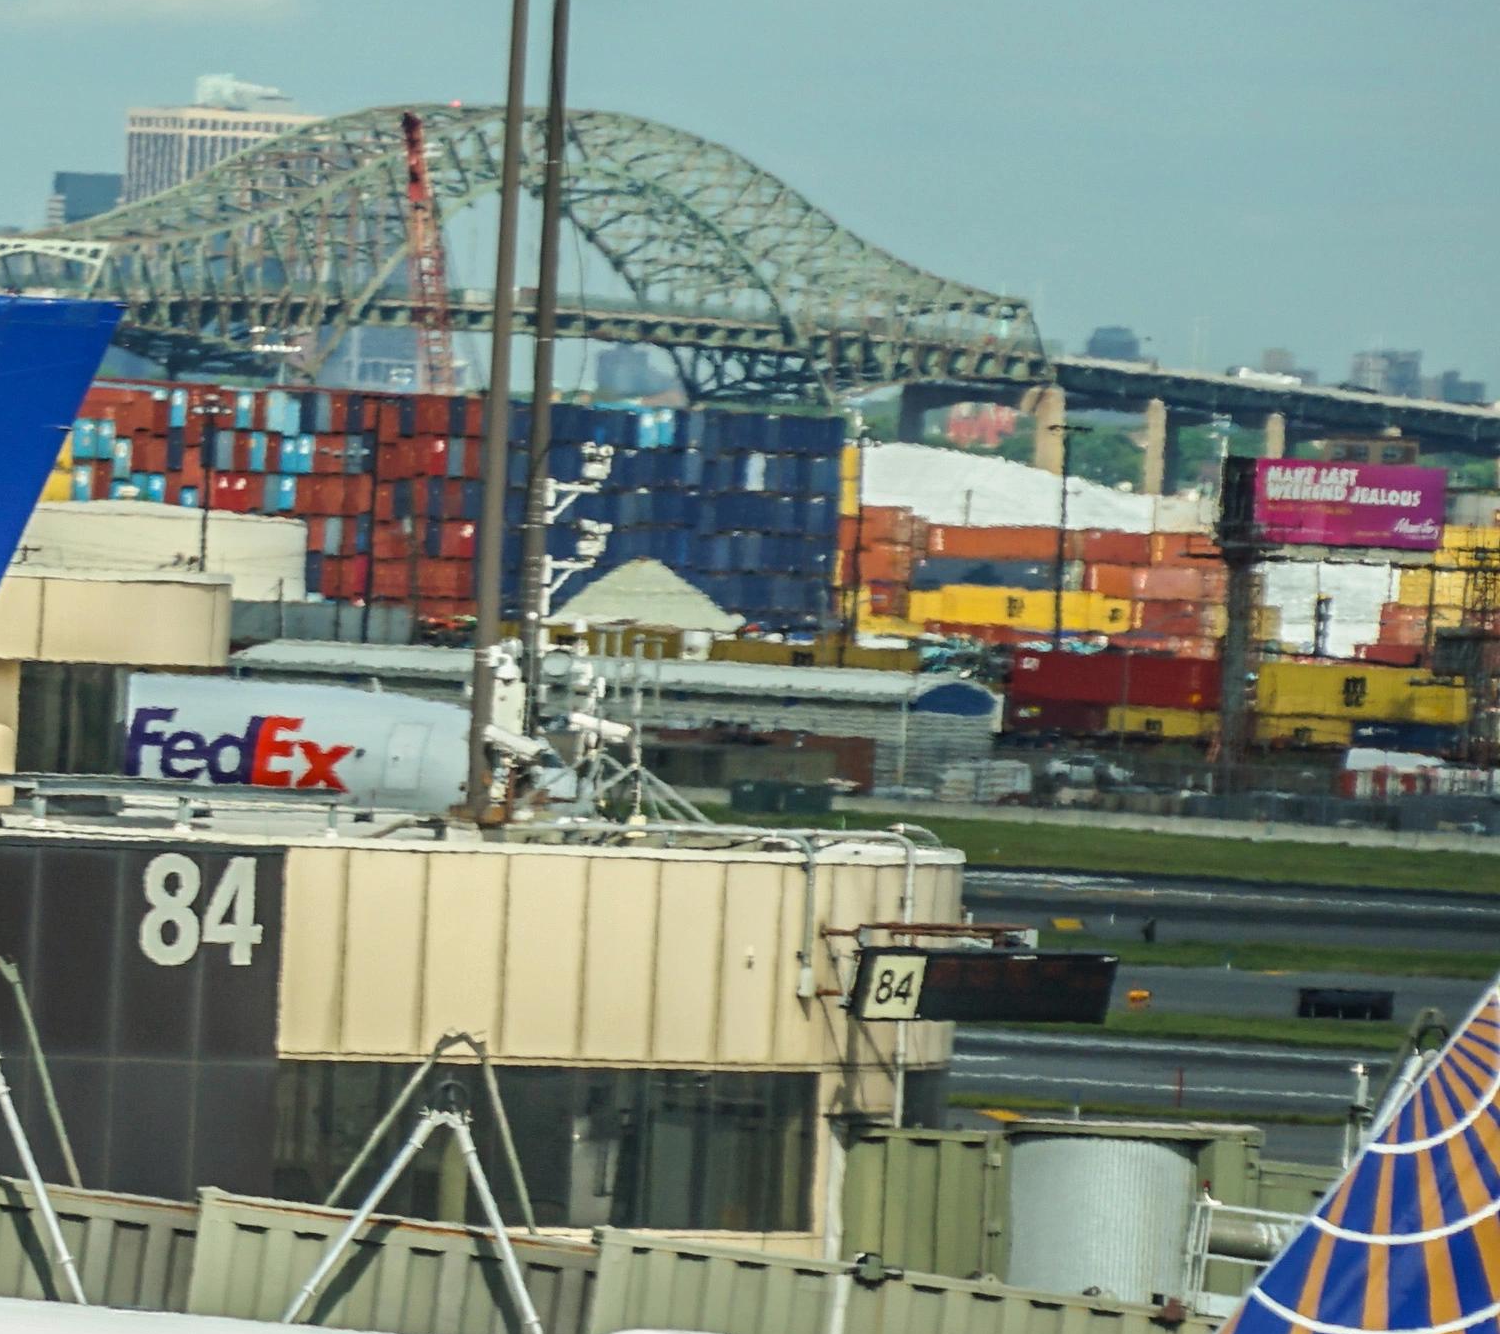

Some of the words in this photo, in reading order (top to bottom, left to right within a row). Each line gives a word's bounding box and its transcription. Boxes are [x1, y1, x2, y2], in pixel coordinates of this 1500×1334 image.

[1320, 469, 1359, 486] LAST
[1266, 485, 1348, 501] WEEKEND
[1350, 487, 1422, 508] JEALOUS
[125, 707, 355, 793] FedEx
[139, 852, 264, 966] 84
[874, 969, 916, 1005] 84
